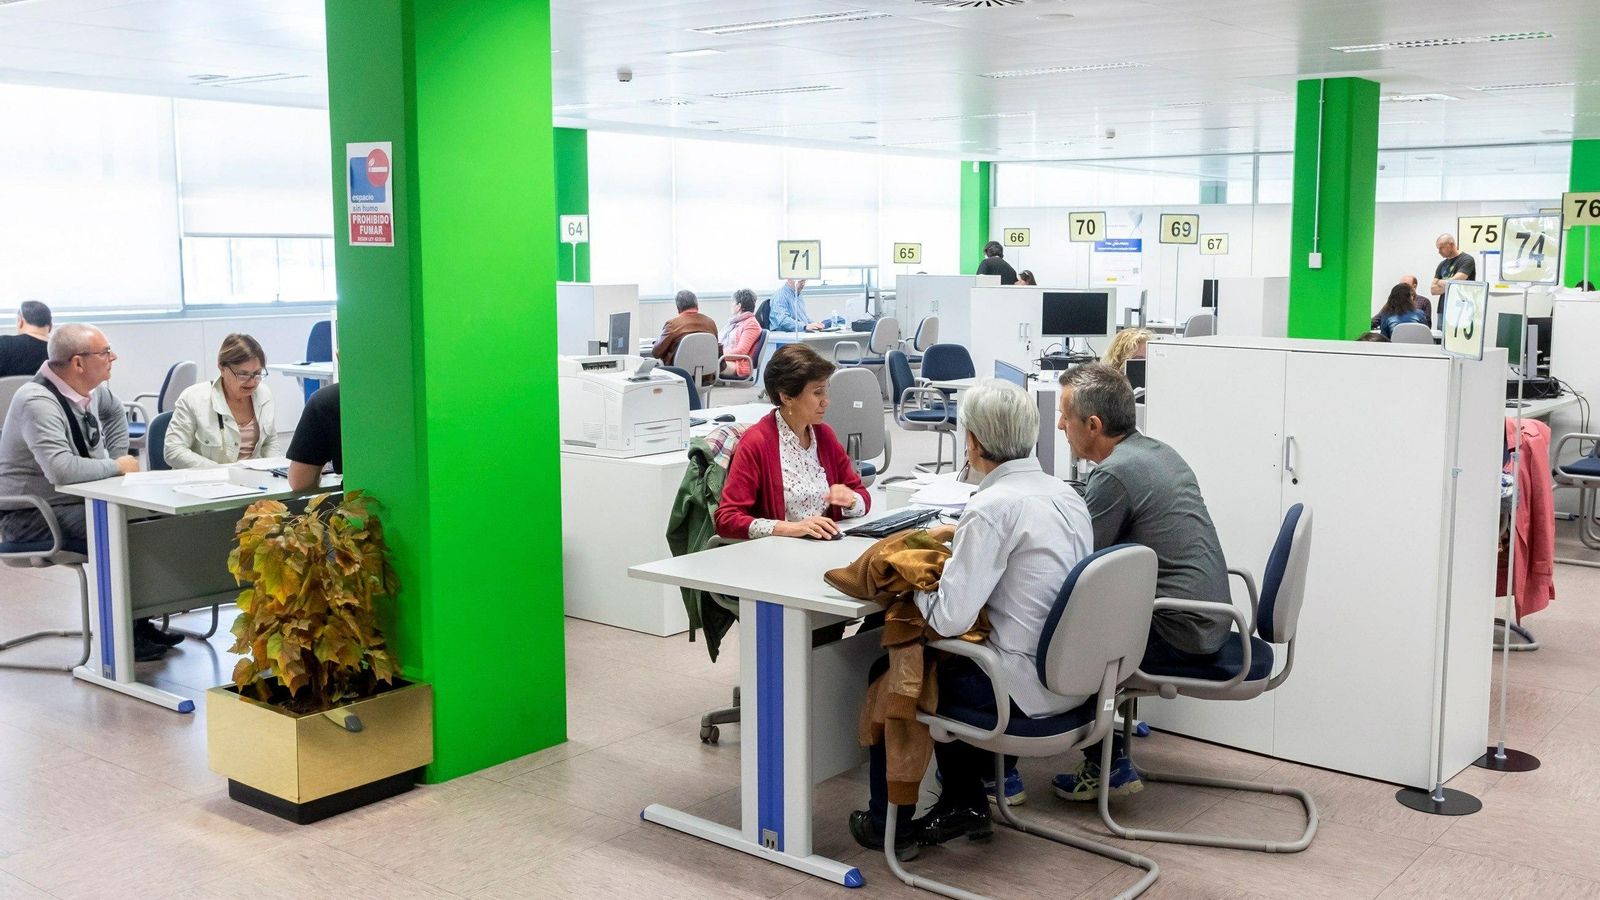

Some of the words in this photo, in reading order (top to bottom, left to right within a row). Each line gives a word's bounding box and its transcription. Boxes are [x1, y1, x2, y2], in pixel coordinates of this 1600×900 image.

[352, 193, 374, 202] espacio
[1574, 199, 1600, 218] 76
[352, 215, 389, 224] PROHIBIDO
[1076, 219, 1095, 235] 70
[359, 225, 383, 235] FUMAR
[568, 221, 583, 236] 64
[1171, 221, 1191, 237] 69
[1470, 225, 1498, 243] 75
[1010, 232, 1024, 243] 66
[1207, 238, 1222, 250] 67
[899, 248, 915, 259] 65
[1515, 231, 1545, 268] 74
[789, 249, 810, 270] 71
